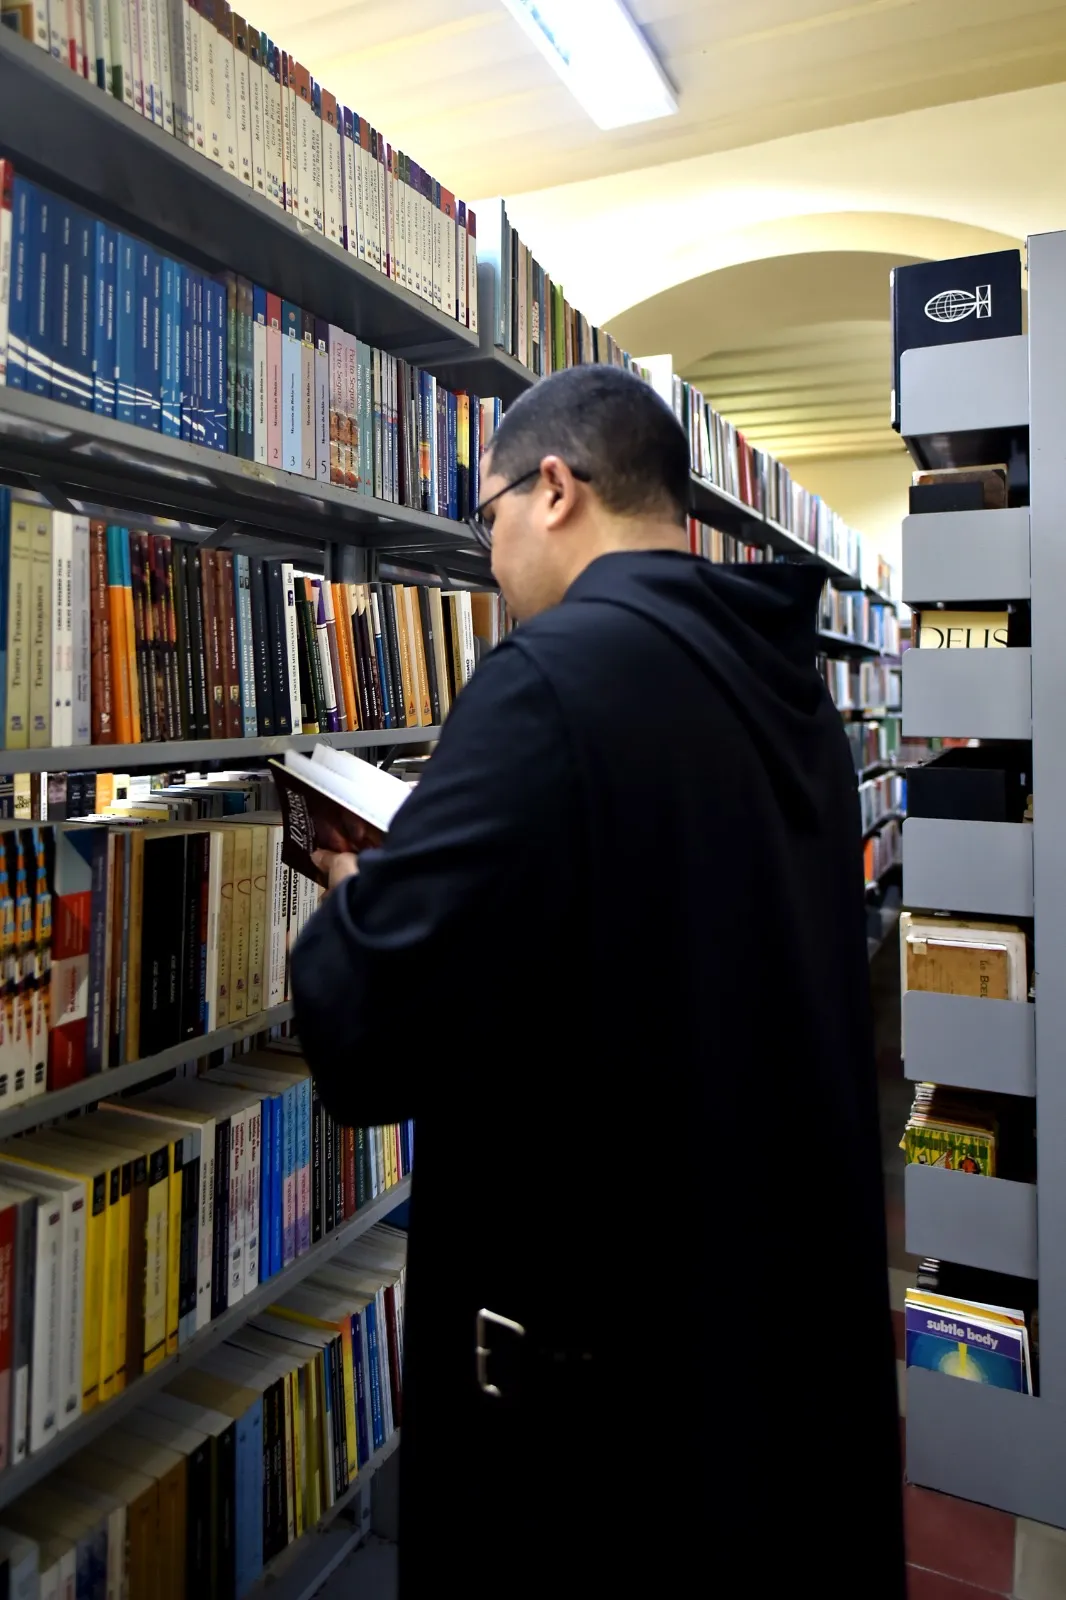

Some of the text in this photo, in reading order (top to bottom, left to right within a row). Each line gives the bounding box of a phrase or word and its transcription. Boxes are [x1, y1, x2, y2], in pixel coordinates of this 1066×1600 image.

[273, 448, 278, 459] 2
[290, 456, 295, 466] 3
[306, 458, 311, 469] 4
[321, 461, 326, 474] 5
[260, 640, 268, 692] CASCALHO
[276, 641, 284, 692] CASCALHO
[927, 1320, 999, 1350] subtle body
